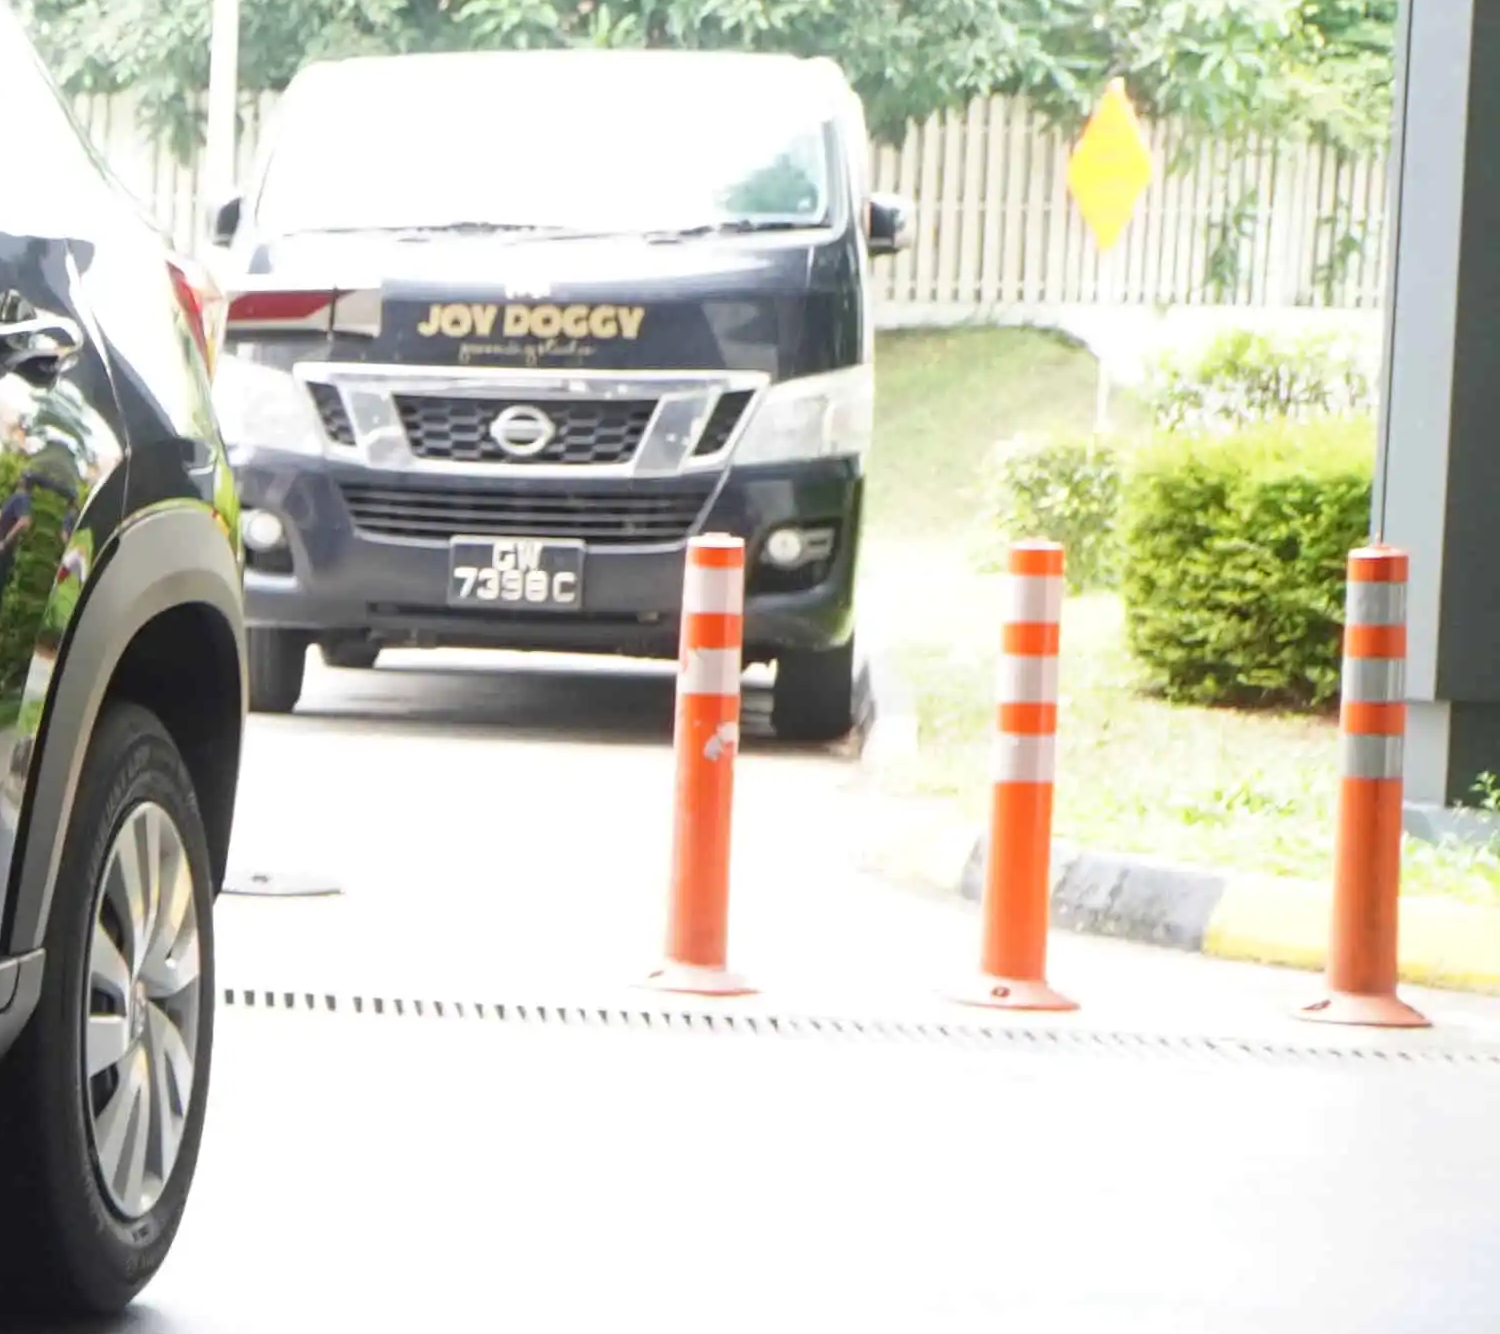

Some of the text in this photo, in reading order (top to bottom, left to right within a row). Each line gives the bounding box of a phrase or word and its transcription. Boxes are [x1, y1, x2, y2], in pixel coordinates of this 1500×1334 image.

[416, 303, 645, 340] JOY DOGGY
[492, 541, 544, 572] GW
